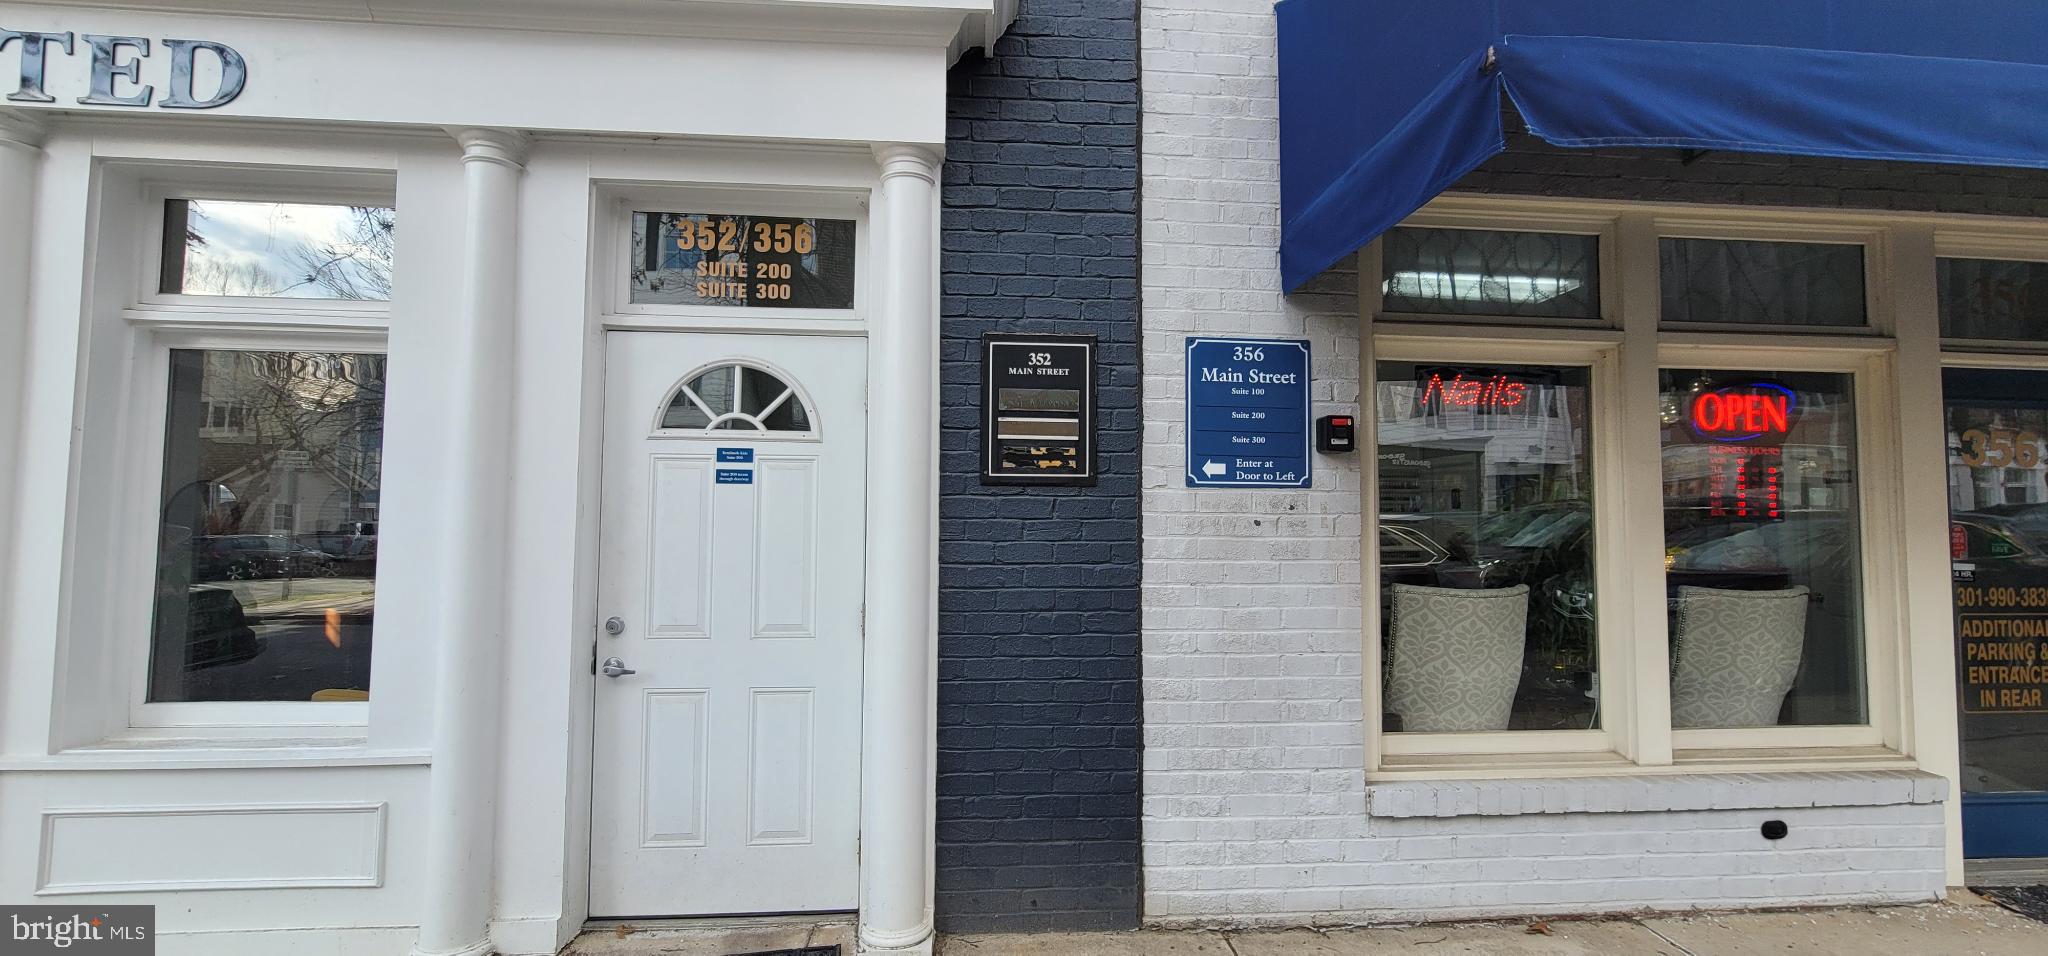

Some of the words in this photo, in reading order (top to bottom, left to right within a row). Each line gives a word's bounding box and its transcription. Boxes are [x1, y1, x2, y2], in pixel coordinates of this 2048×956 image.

[0, 28, 247, 109] TED
[676, 219, 812, 254] 352/356
[696, 262, 748, 278] SUITE
[756, 263, 792, 279] 200
[696, 282, 748, 298] SUITE
[756, 283, 791, 300] 300
[1028, 352, 1052, 366] 352
[1233, 346, 1265, 361] 356
[1008, 367, 1034, 375] MAIN
[1036, 368, 1070, 376] STREET
[1201, 367, 1244, 383] Main
[1248, 369, 1297, 384] Street
[1251, 388, 1265, 396] 100
[1421, 373, 1526, 406] Nails
[1231, 411, 1249, 419] Suite
[1694, 392, 1788, 432] OPEN
[1231, 436, 1250, 444] Suite
[1961, 428, 2038, 468] 356
[1236, 459, 1262, 468] Enter
[1264, 460, 1274, 468] at
[1236, 471, 1261, 480] Door
[1263, 472, 1274, 480] to
[1276, 472, 1295, 481] Left
[1968, 643, 2035, 661] PARKING
[1969, 667, 2048, 684] ENTRANCE
[1981, 690, 1995, 707] IN
[2001, 690, 2041, 706] REAR
